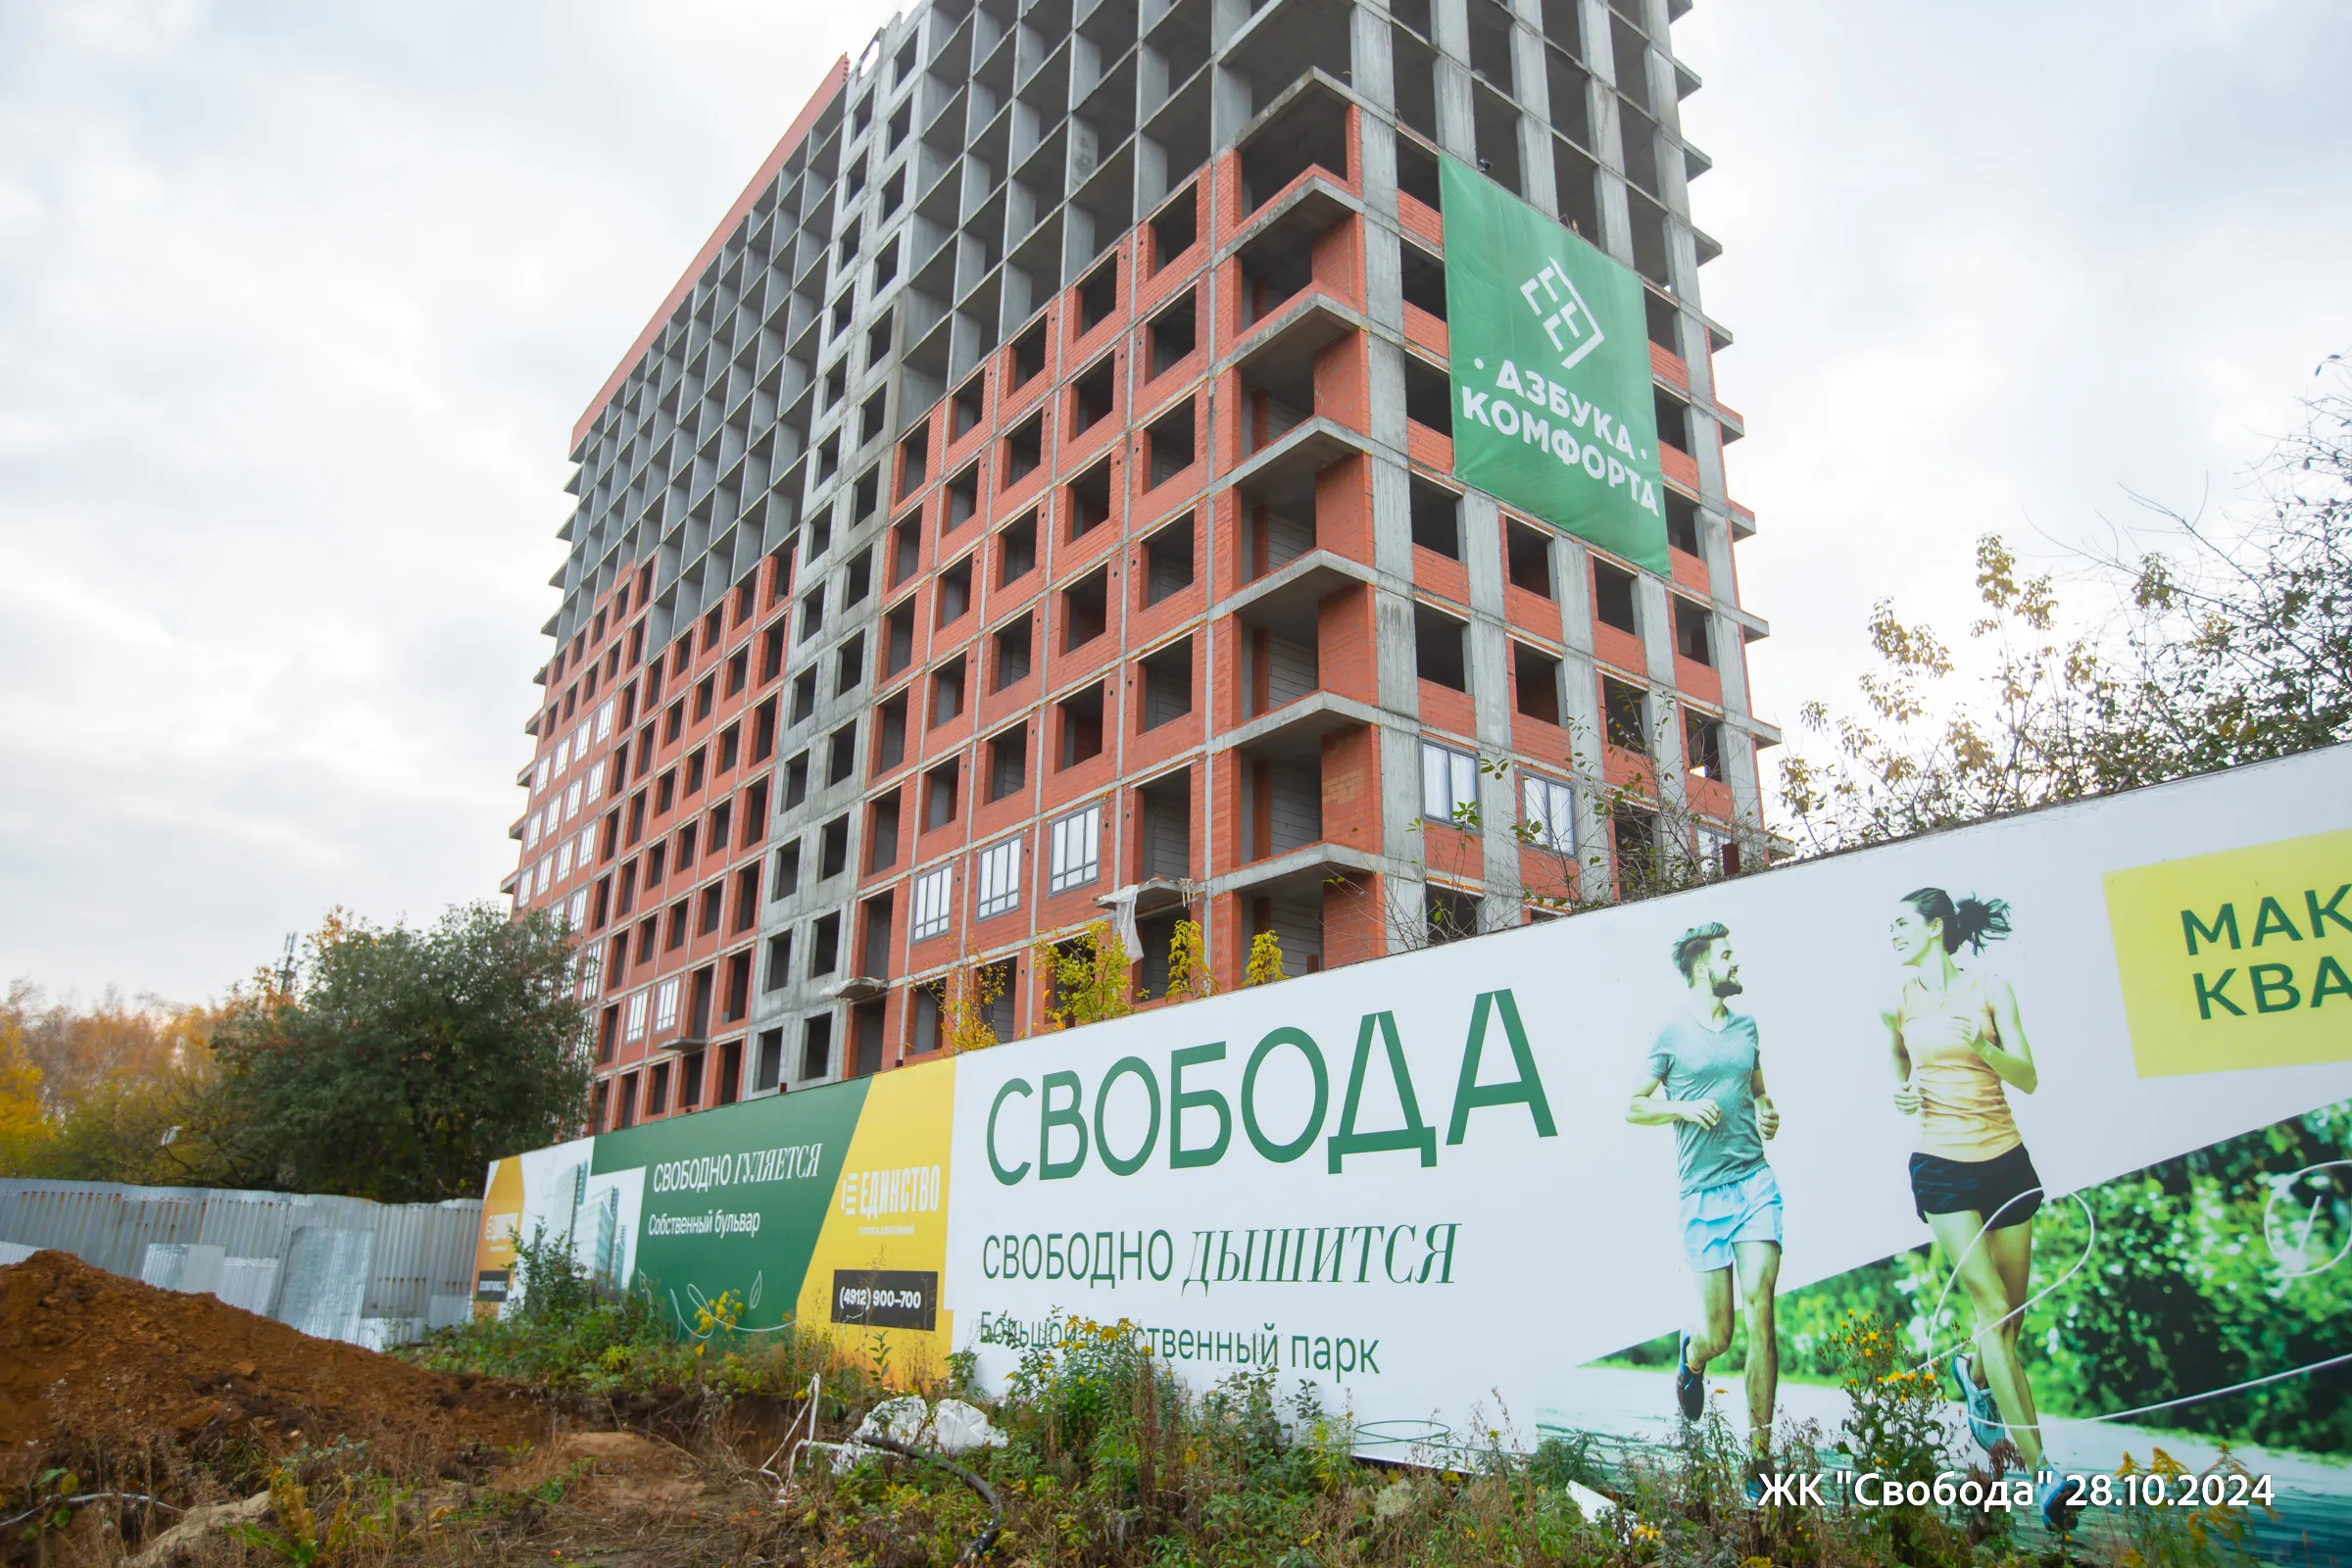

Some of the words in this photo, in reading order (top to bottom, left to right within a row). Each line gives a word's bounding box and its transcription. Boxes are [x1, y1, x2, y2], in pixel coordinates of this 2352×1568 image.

[1495, 359, 1636, 460] АЗБУКА
[1461, 385, 1660, 517] КОМФОРТА
[2180, 883, 2352, 956] МАК
[2192, 956, 2352, 1020] КВА
[986, 988, 1558, 1186] СВОБОДА
[654, 1153, 732, 1193] СВОБОДНО
[733, 1143, 823, 1185] ГУЛЯЕТСЯ
[859, 1164, 941, 1220] ЕДИНСТВО
[649, 1209, 713, 1236] Собственный
[714, 1209, 760, 1239] бульвар
[982, 1228, 1173, 1289] СВОБОДНО
[1181, 1222, 1463, 1298] ДЫШИТСЯ
[839, 1286, 871, 1310] (4912)
[872, 1290, 921, 1309] 900-700
[1291, 1335, 1381, 1384] парк
